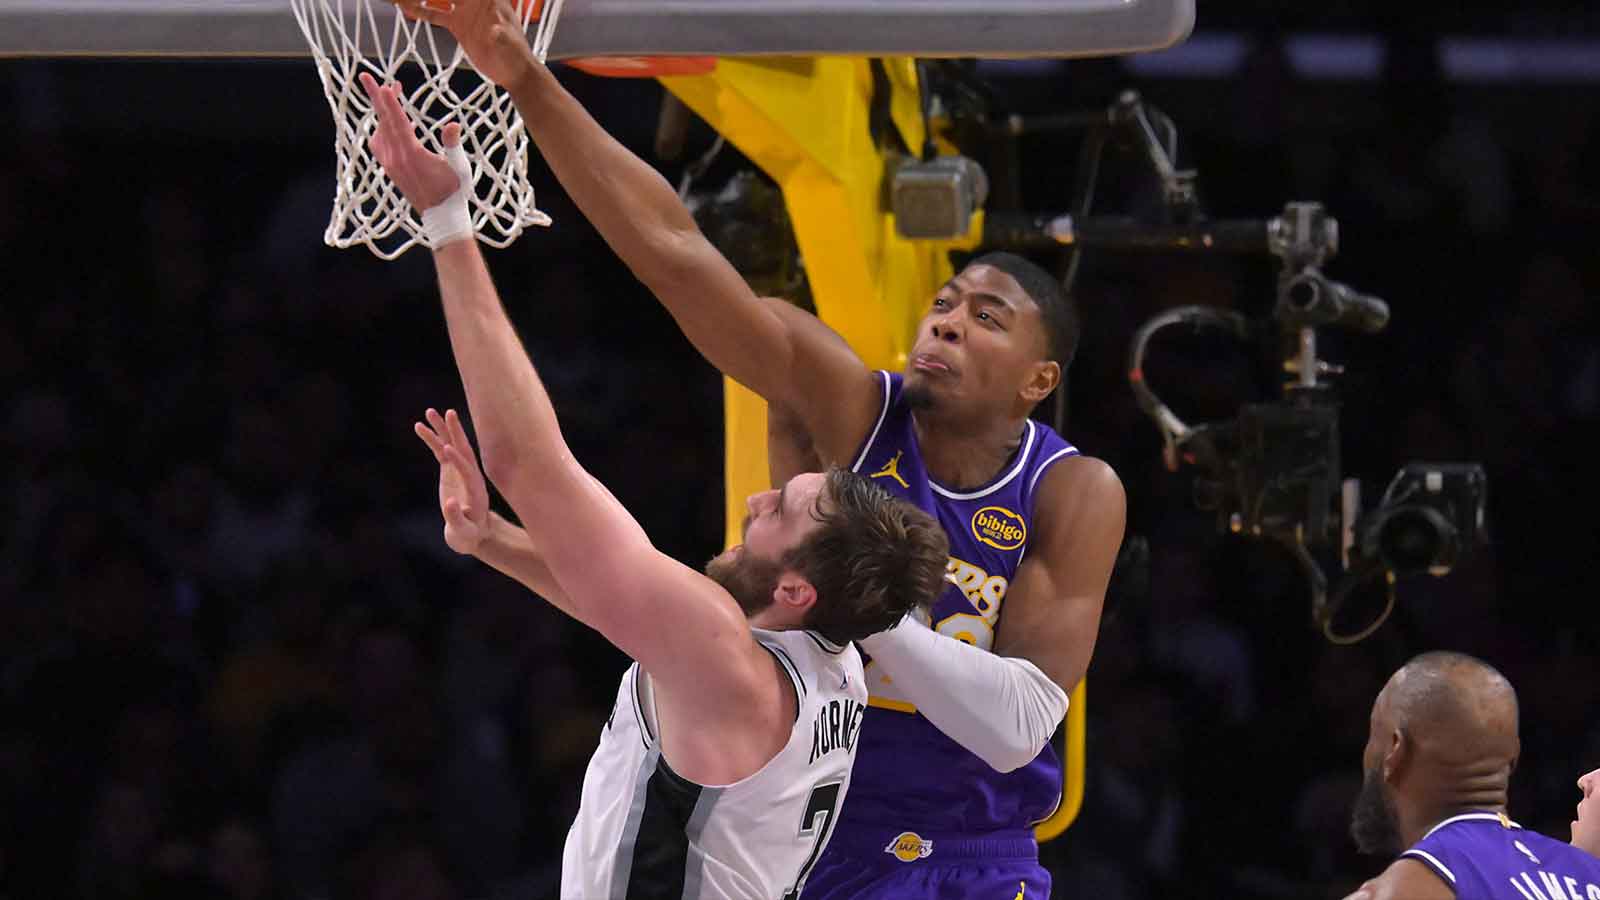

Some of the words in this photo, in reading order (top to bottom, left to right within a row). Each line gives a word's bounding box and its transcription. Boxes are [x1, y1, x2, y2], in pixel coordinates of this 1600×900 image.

[977, 513, 1023, 541] bibigo
[809, 699, 864, 765] KORNE
[781, 775, 845, 900] 7
